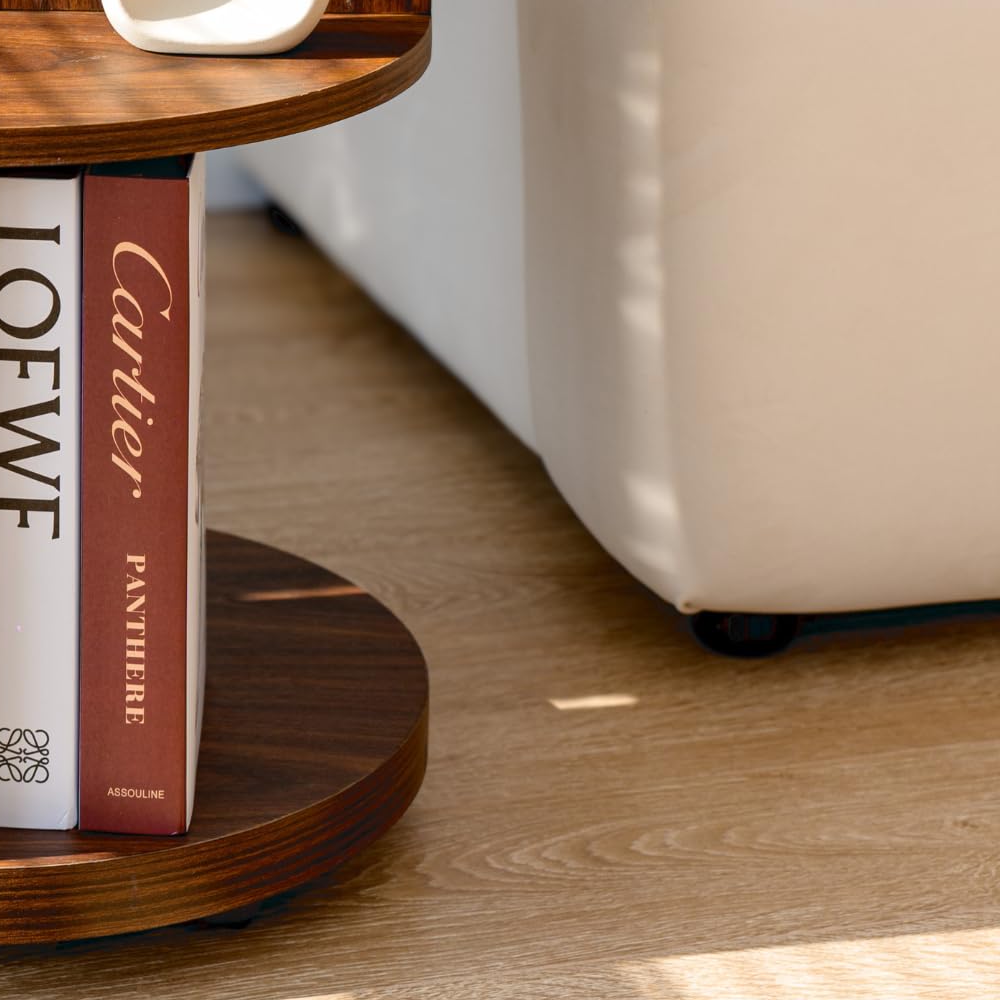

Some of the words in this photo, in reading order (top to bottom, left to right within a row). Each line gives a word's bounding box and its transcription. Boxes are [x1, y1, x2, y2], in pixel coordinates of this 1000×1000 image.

[112, 241, 173, 499] Cartier
[125, 553, 146, 725] PANTHERE
[107, 787, 165, 800] ASSOULINE
